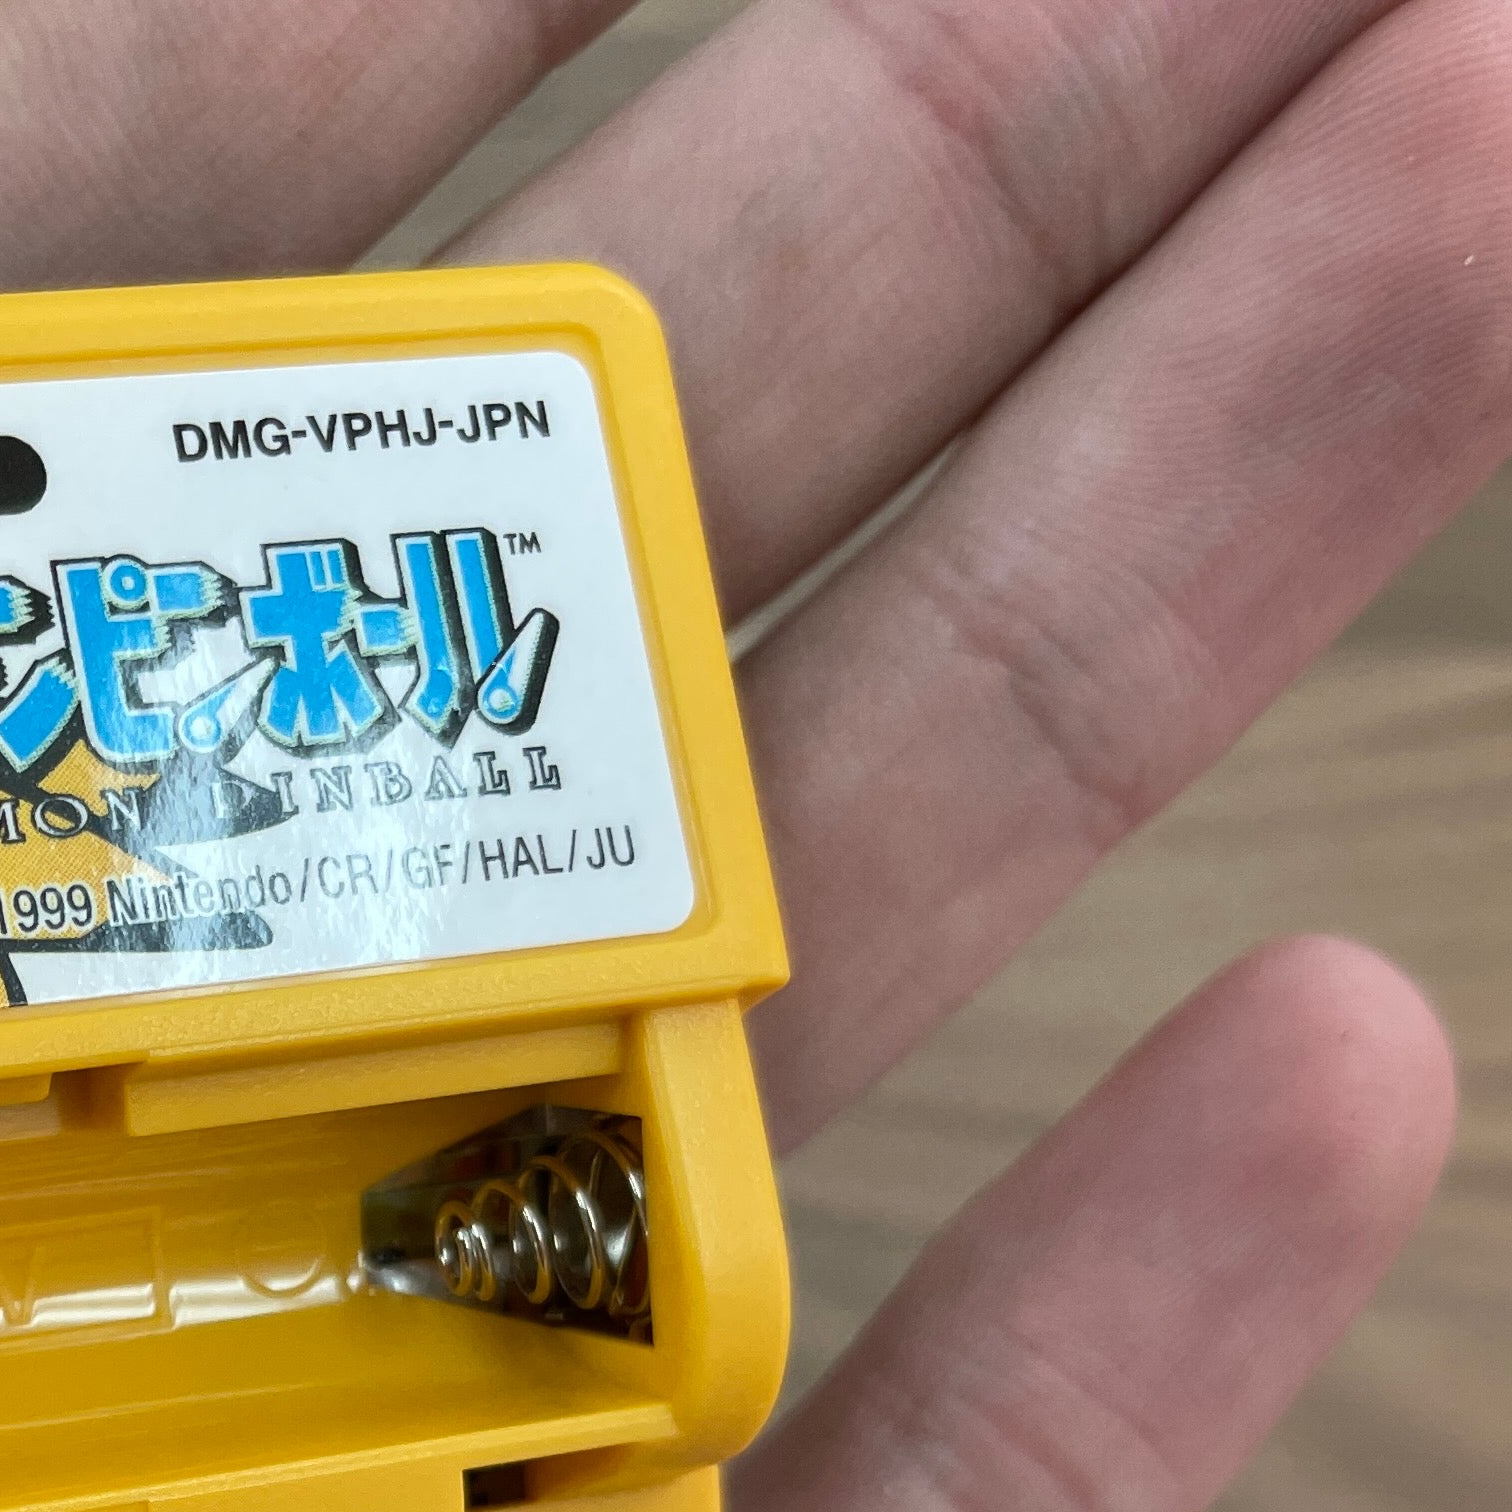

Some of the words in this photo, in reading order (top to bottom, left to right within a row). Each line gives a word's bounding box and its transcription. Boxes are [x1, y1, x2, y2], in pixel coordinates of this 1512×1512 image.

[172, 400, 551, 463] DMG-VPHJ-JPN
[210, 744, 564, 822] PINBALL
[104, 825, 638, 926] Nintendo/CR/GF/HAL/JU
